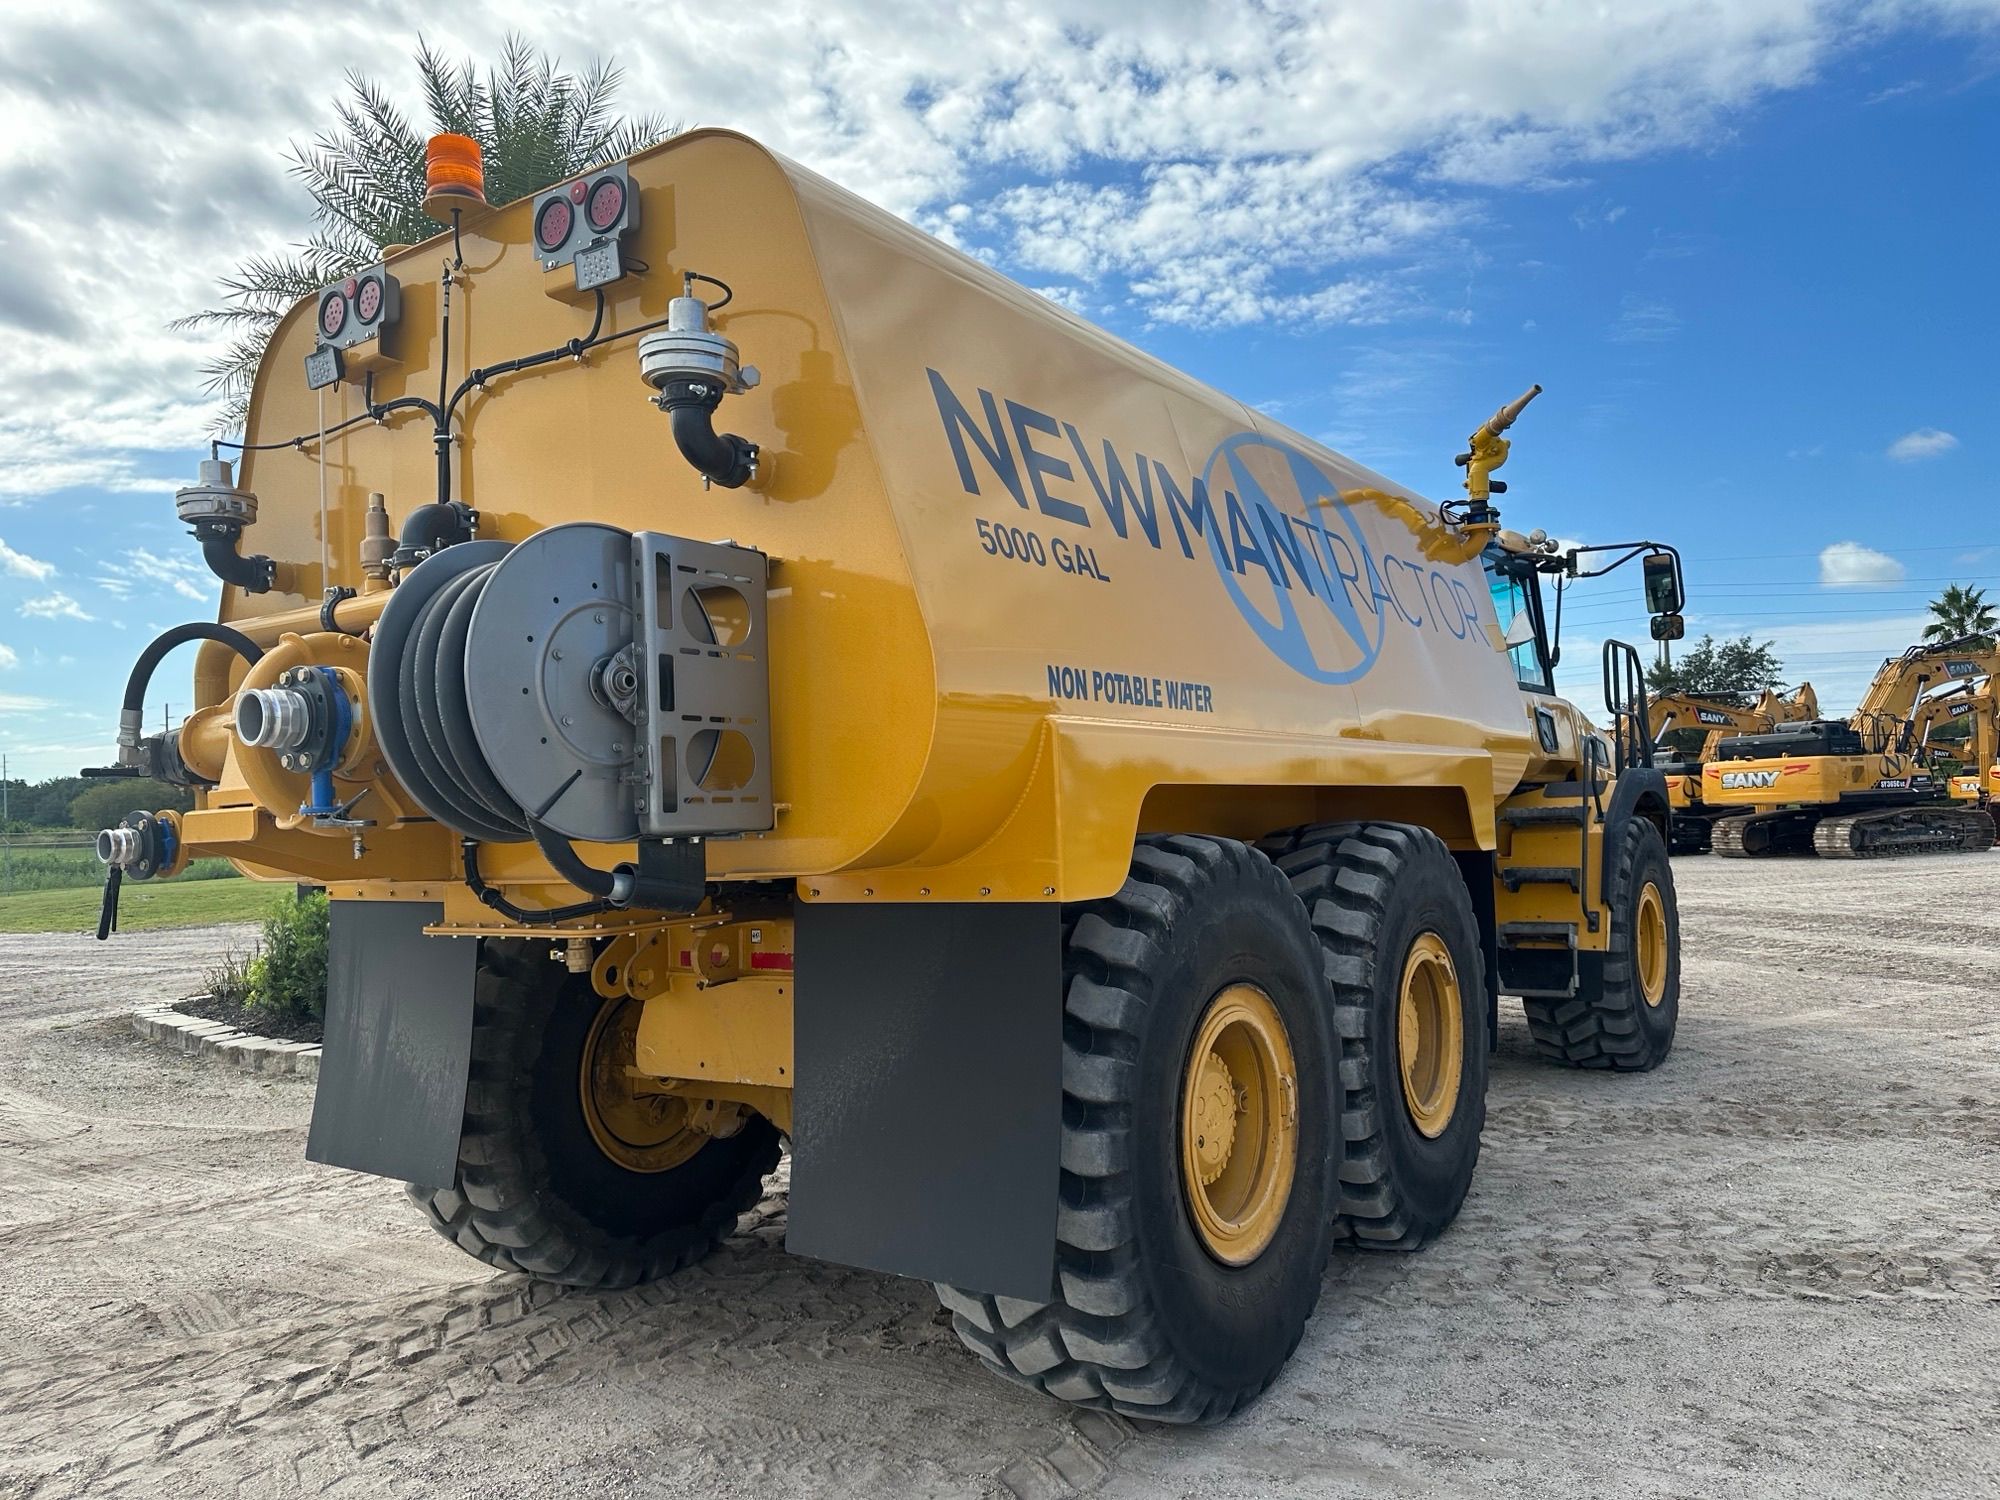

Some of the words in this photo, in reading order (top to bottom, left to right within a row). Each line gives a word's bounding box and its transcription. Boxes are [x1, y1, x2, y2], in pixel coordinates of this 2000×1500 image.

[976, 518, 1047, 567] 5000
[1051, 538, 1111, 582] GAL
[1949, 663, 1973, 675] SANY
[1047, 664, 1088, 700] NON
[1092, 670, 1163, 708] POTABLE
[1165, 680, 1213, 712] WATER
[1700, 712, 1726, 724] SANY
[1721, 771, 1781, 790] SANY
